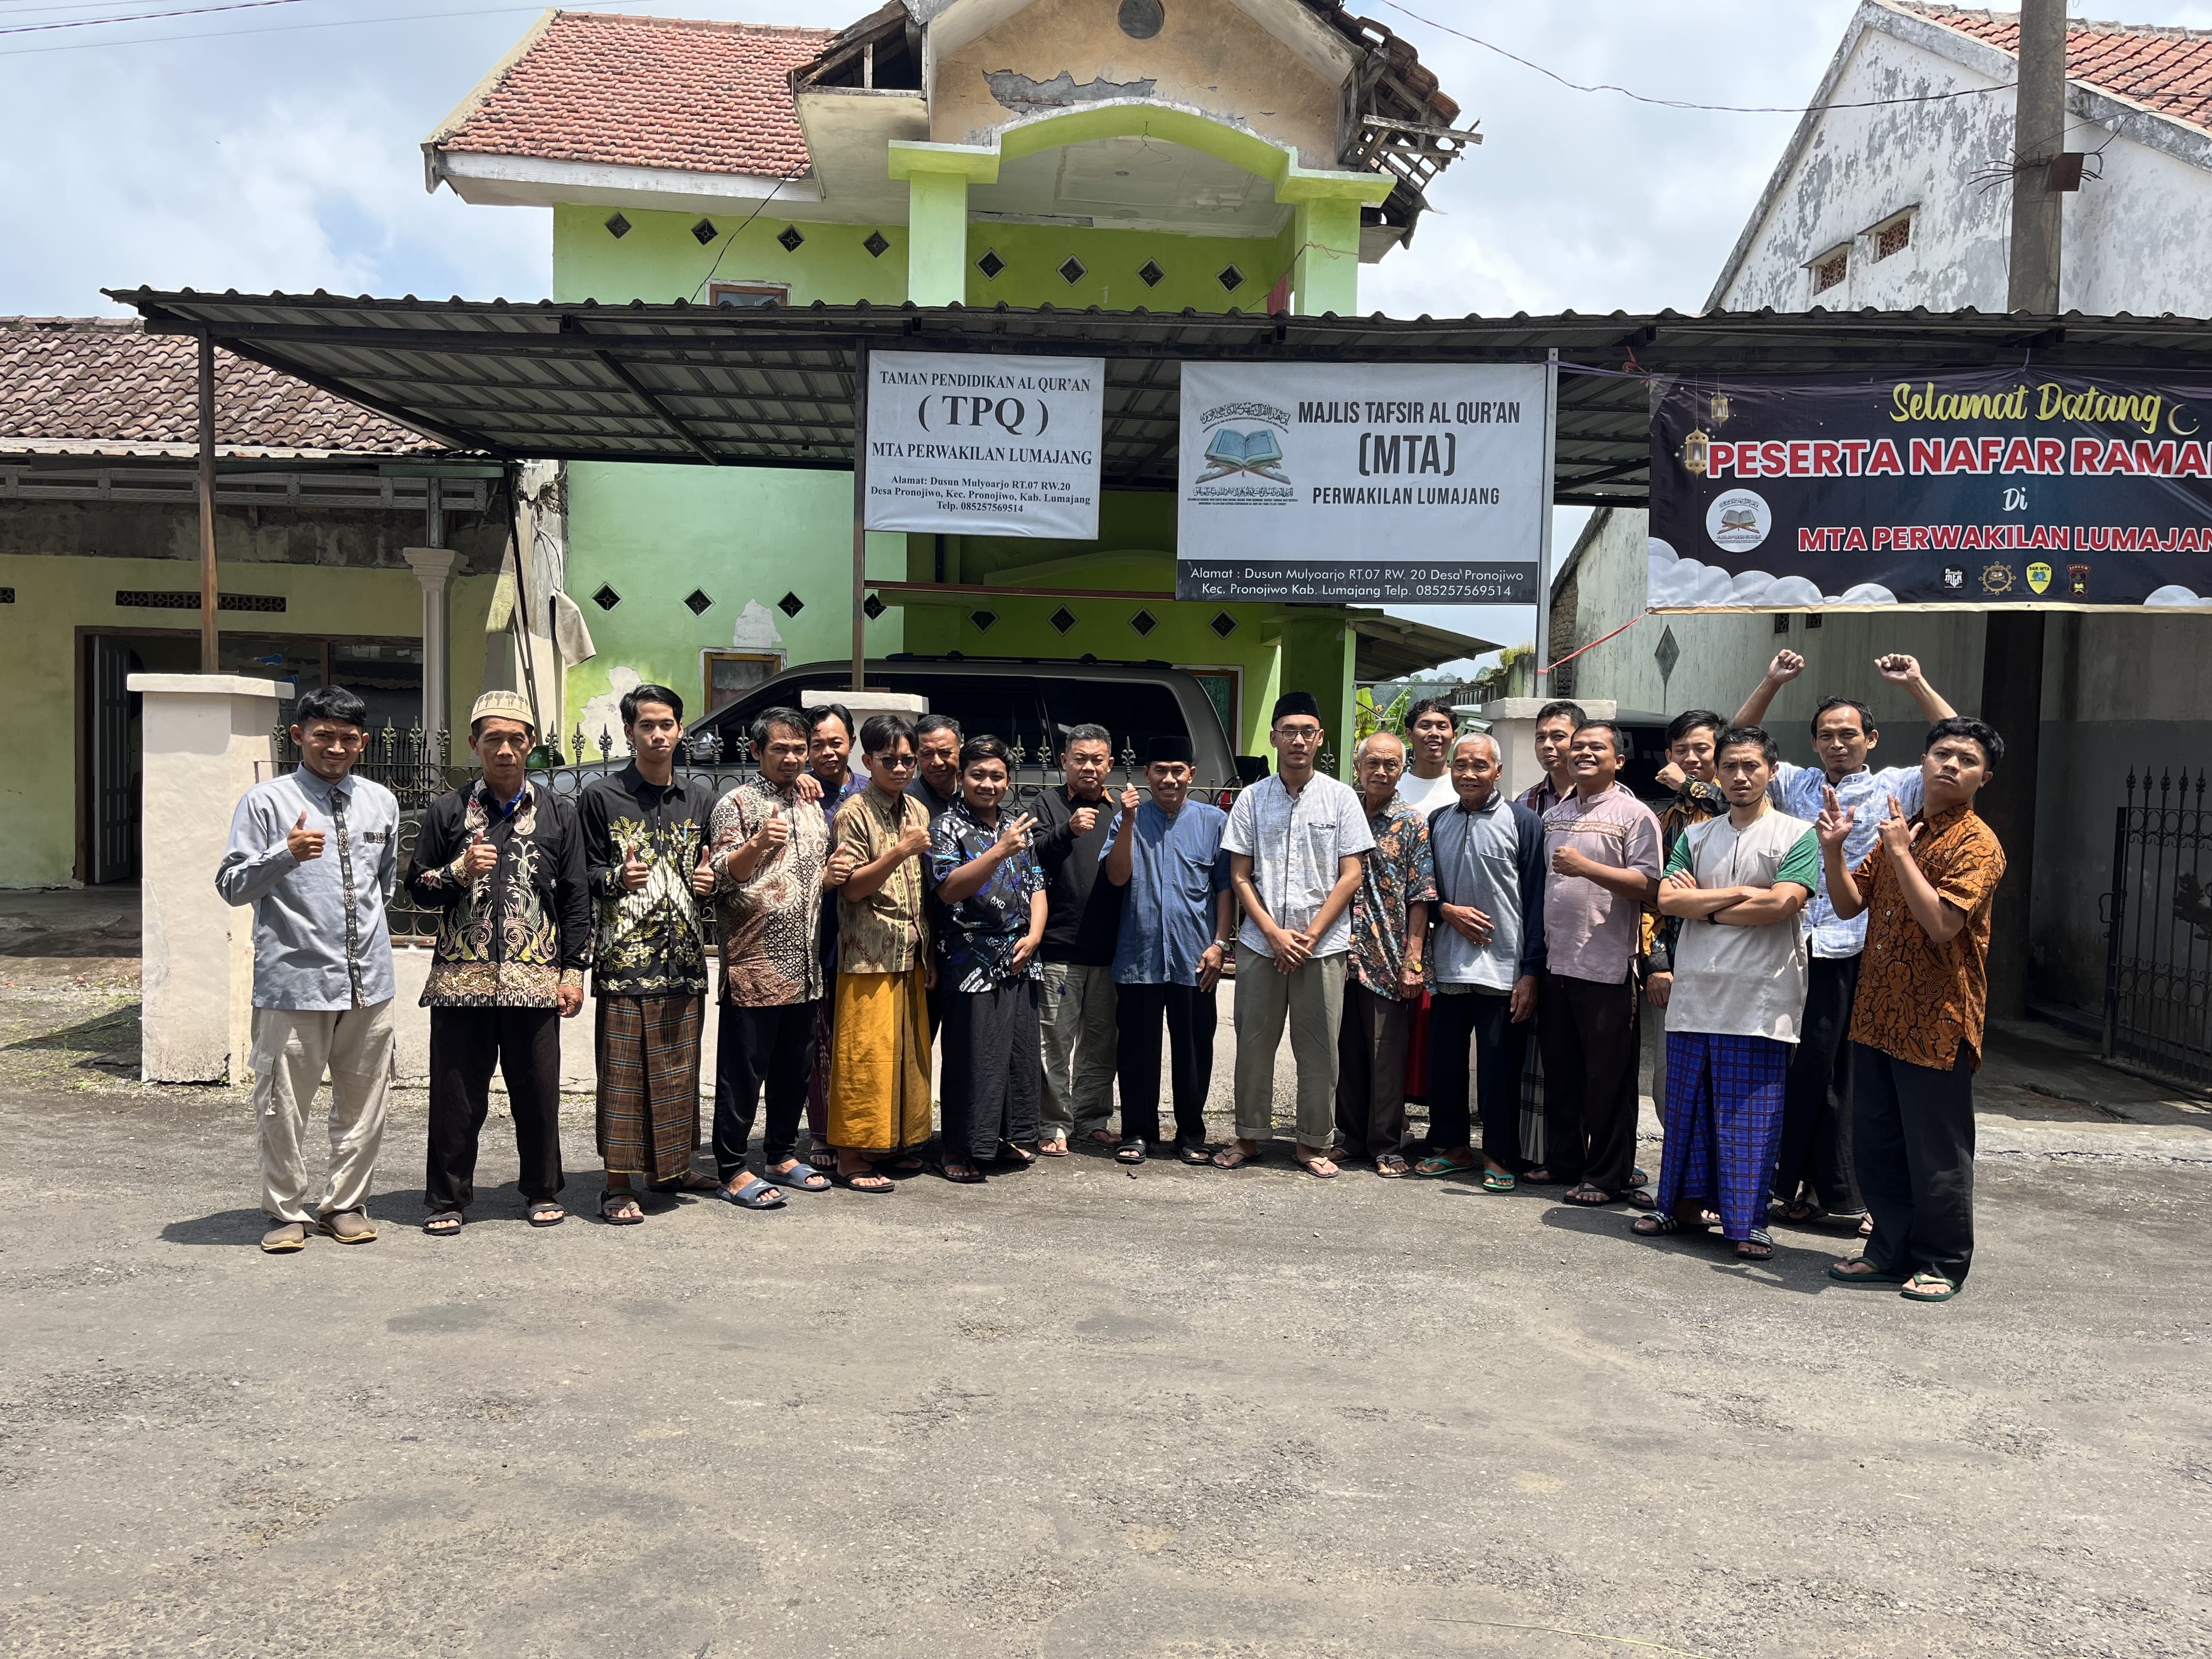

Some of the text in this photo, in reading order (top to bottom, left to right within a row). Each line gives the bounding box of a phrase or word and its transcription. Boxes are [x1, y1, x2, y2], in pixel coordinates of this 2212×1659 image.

[881, 371, 927, 385] TAMAN
[932, 374, 1014, 388] PENDIDIKAN
[1018, 377, 1035, 389] AL
[1299, 402, 1359, 423] MAJLIS
[1365, 402, 1424, 423] TAFSIR
[1429, 402, 1451, 423] AL
[1889, 382, 2162, 434] Selamat Datang
[873, 443, 1091, 465] MTA PERWAKILAN LUMAJANG
[1359, 433, 1455, 476] (MTA)
[1707, 437, 2212, 478] PESERTA NAFAR RAMA
[891, 476, 1070, 490] Alamat: Dusun Mulyoarjo RT.07 RW.20
[871, 487, 1090, 505] Desa Pronojiwo, Kec. Pronojiwo, Kab. Lumajang
[1313, 488, 1412, 504] PERWAKILAN
[1418, 488, 1499, 504] LUMAJANG
[2002, 487, 2028, 511] Di
[937, 501, 1023, 512] Telp. 085257569514
[1798, 527, 1868, 551] MTA
[1872, 525, 2071, 550] PERWAKILAN
[1191, 567, 1233, 578] Alamat
[1245, 568, 1282, 578] Dusun
[1286, 568, 1345, 582] Mulyoarjo
[1350, 569, 1380, 579] RT.07
[1385, 569, 1405, 579] RW.
[1411, 569, 1425, 579] 20
[1431, 570, 1459, 579] Desa
[1465, 570, 1523, 583] Pronojiwo
[1203, 583, 1510, 597] Kec. Pronojiwo Kab. Lumajang Telp. 085257569514
